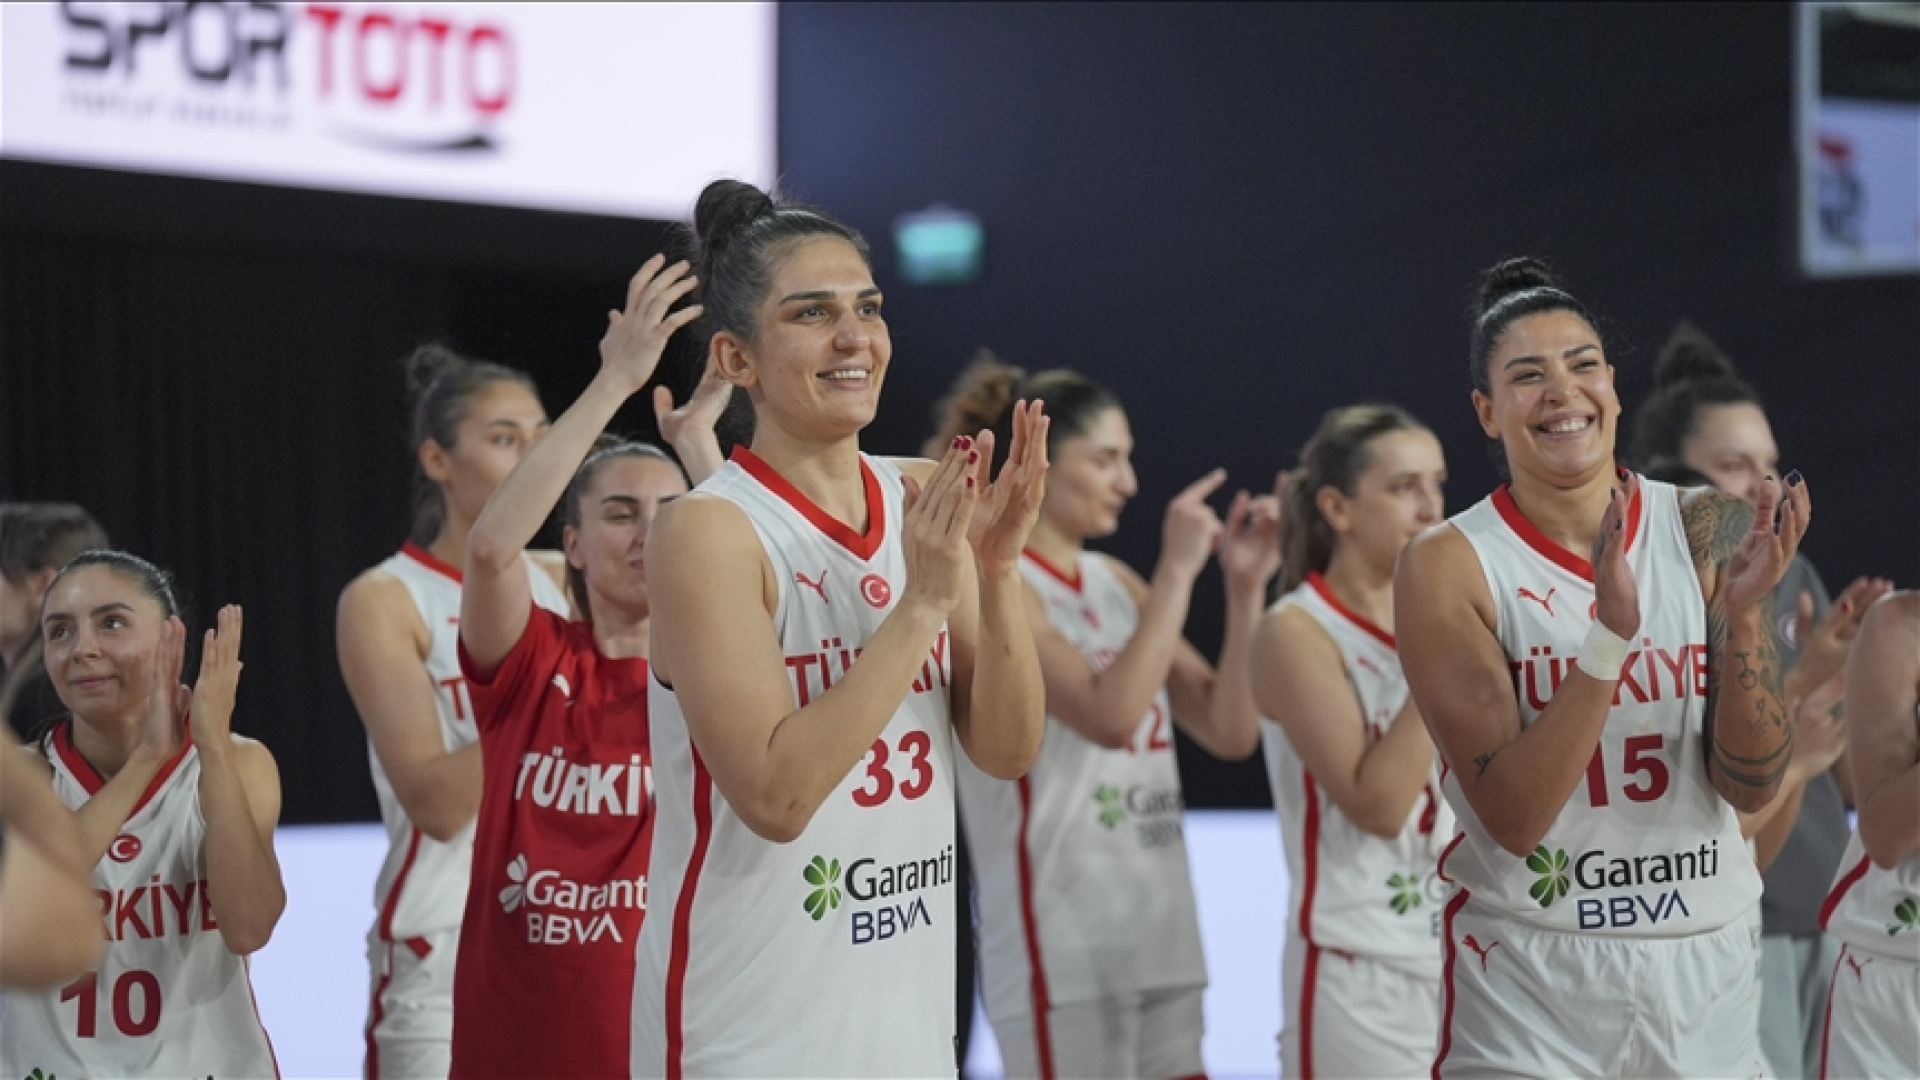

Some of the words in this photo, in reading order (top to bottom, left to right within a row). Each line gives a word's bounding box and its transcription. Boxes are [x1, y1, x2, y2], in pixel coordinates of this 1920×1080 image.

[852, 730, 933, 807] 33
[1586, 734, 1670, 807] 15
[844, 844, 953, 901] Garanti
[1574, 840, 1719, 890] Garanti
[527, 913, 623, 946] BBVA
[851, 896, 932, 945] BBVA
[1577, 889, 1690, 930] BBVA
[59, 968, 163, 1039] 10
